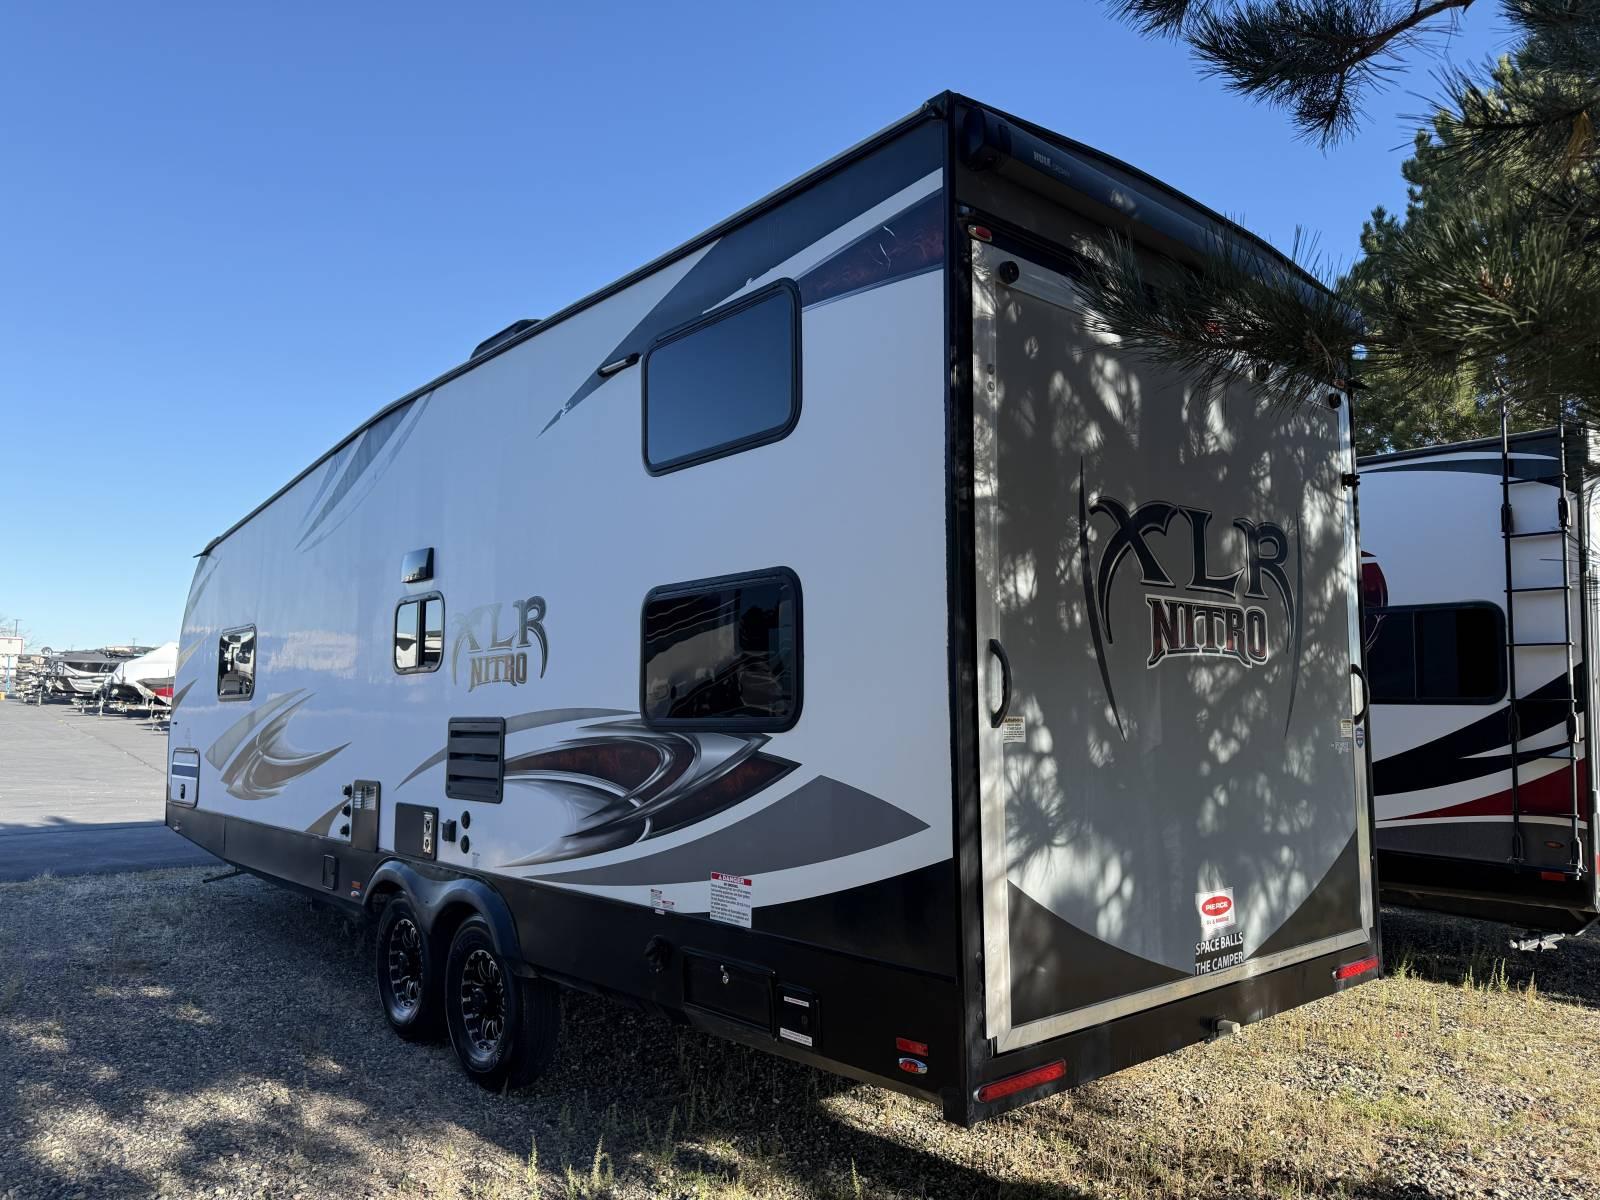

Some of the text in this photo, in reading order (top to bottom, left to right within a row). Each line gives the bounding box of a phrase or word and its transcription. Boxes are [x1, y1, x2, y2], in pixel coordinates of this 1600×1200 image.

[1088, 496, 1296, 654] XLR
[452, 595, 548, 686] XLR
[1145, 593, 1268, 669] NITRO
[468, 652, 528, 693] NITRO
[722, 874, 744, 885] DANGER
[1195, 931, 1243, 956] SPACE BALLS
[1195, 951, 1244, 976] THE CAMPER
